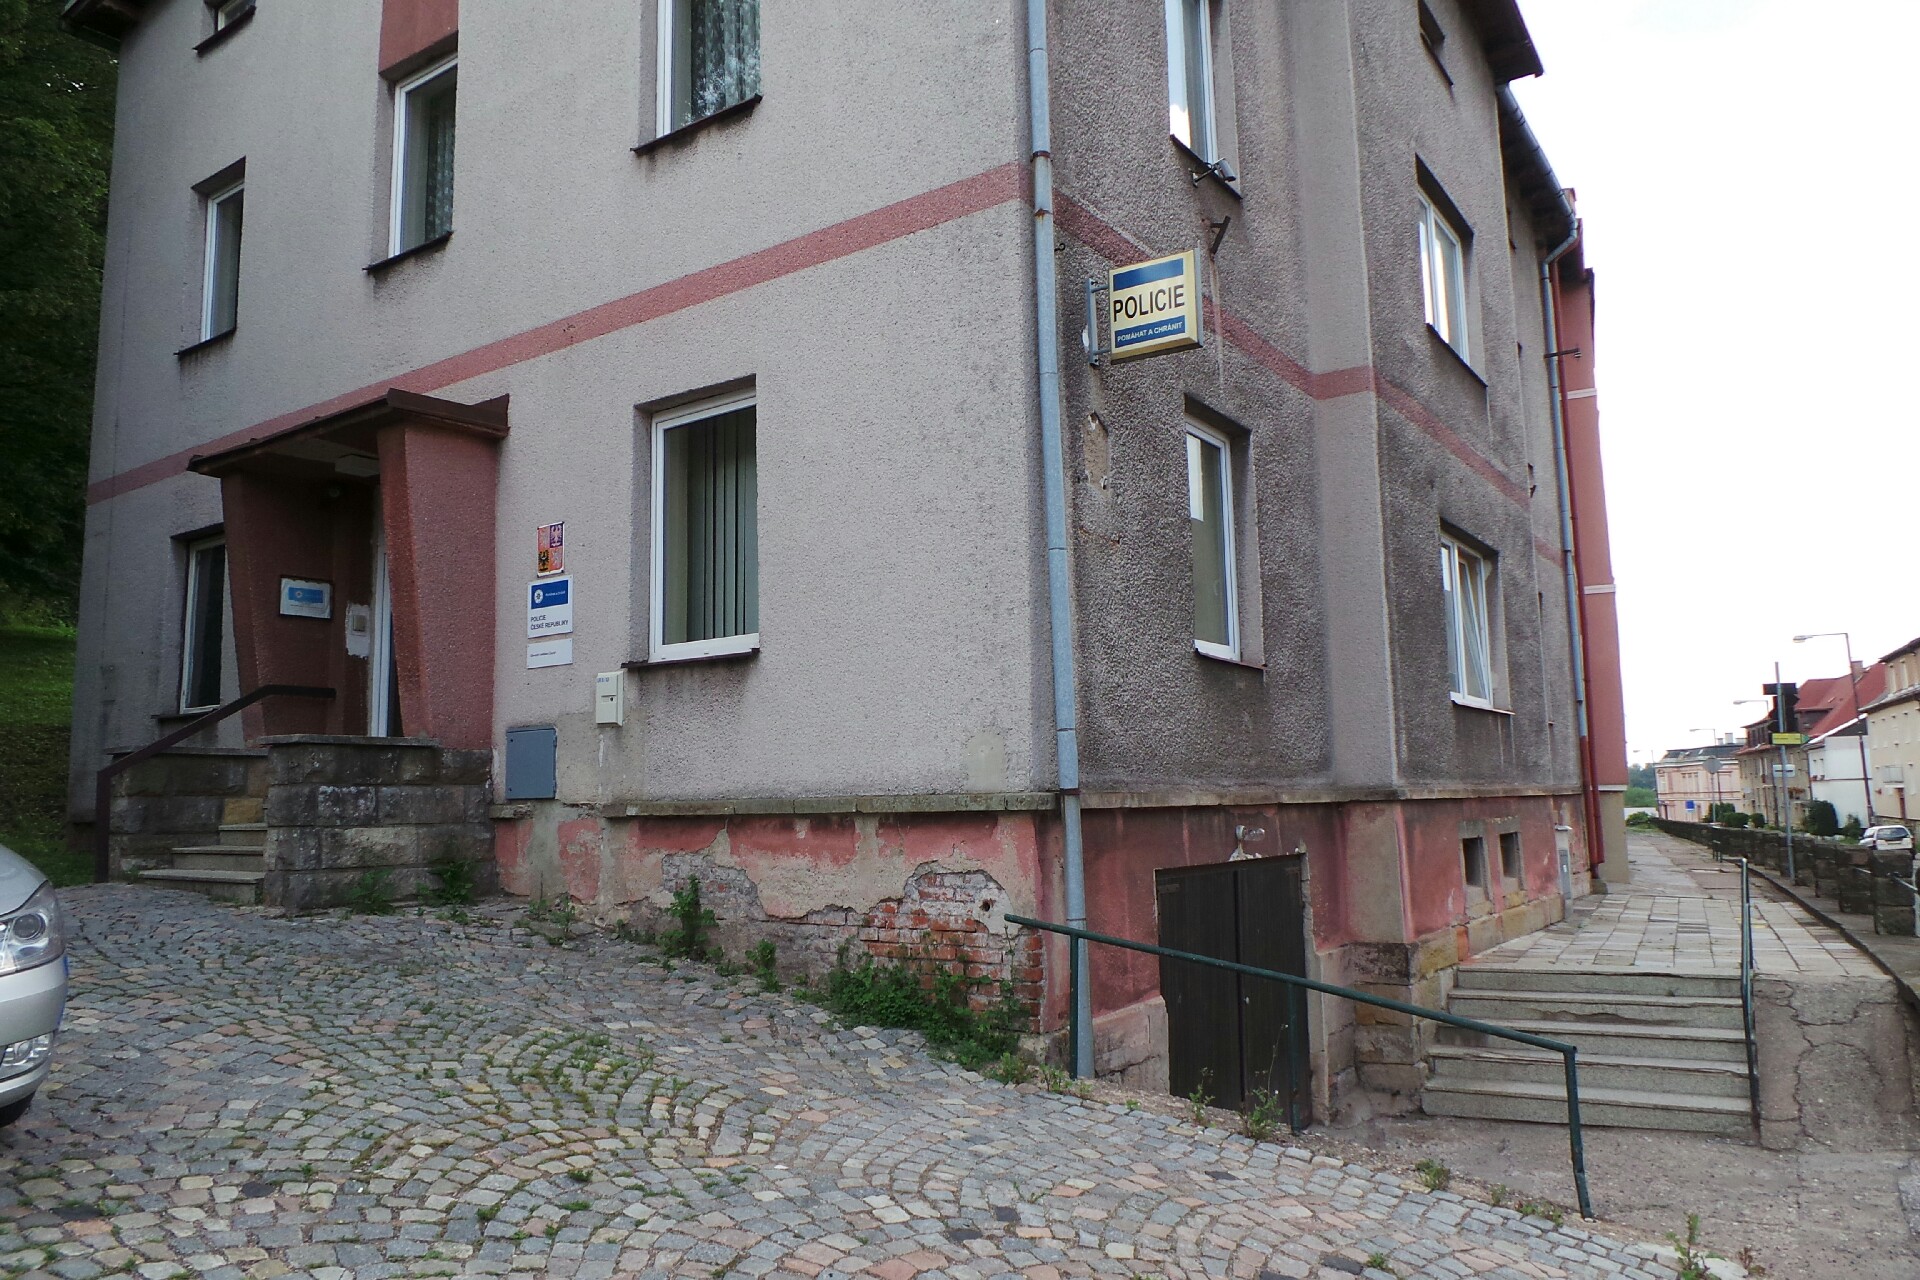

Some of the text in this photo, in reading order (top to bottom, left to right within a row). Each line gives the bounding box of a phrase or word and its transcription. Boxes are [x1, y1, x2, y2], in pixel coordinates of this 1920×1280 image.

[1113, 284, 1185, 322] POLICIE
[1117, 330, 1147, 342] POMÁHAT
[1154, 322, 1182, 334] CHRÁNIT
